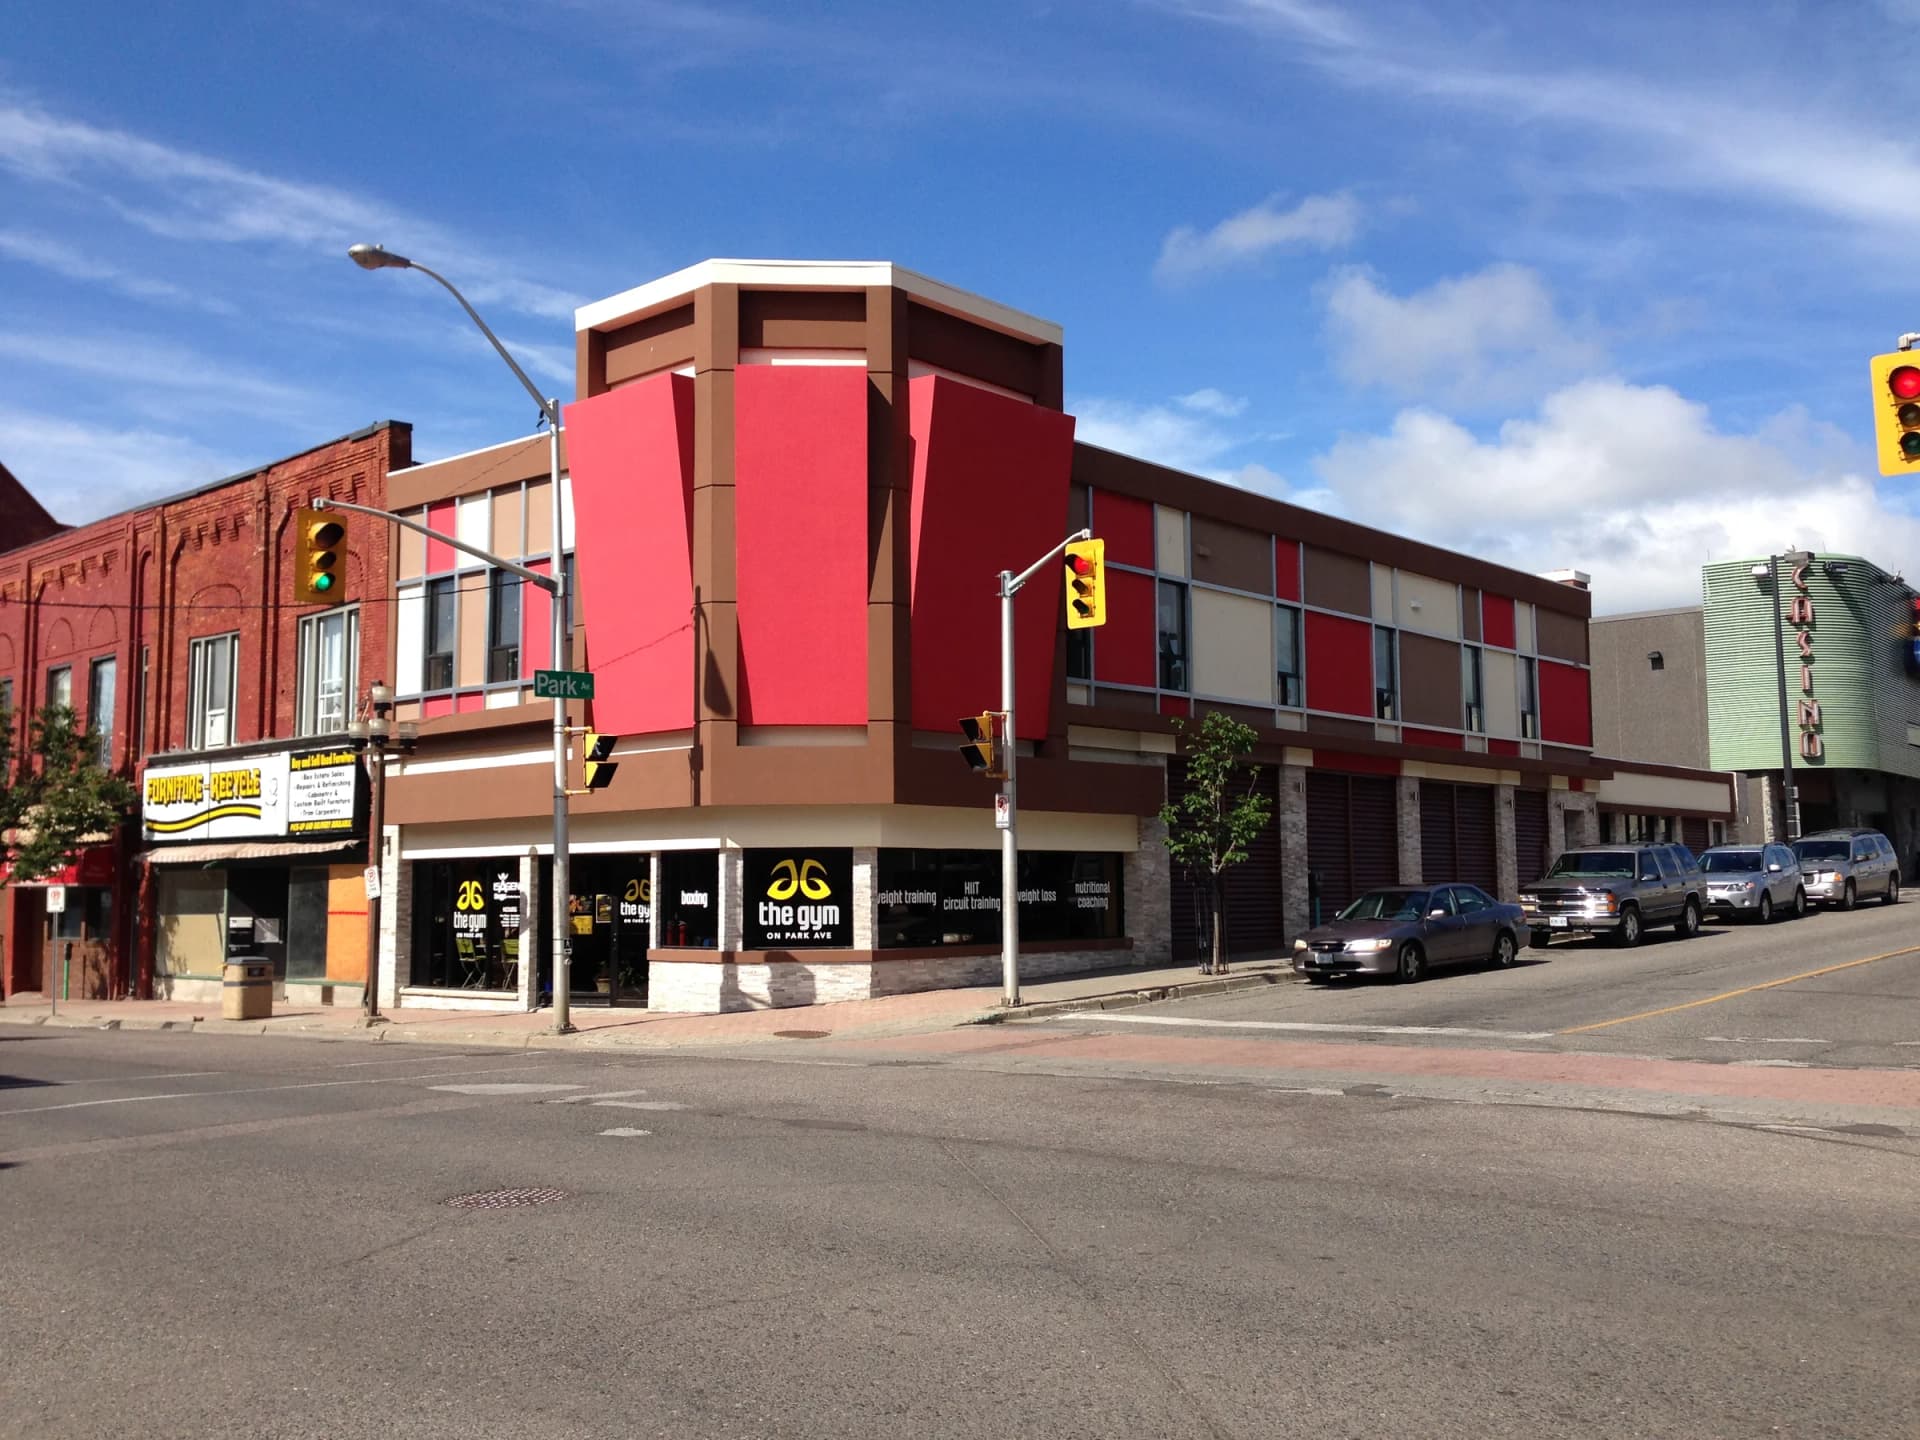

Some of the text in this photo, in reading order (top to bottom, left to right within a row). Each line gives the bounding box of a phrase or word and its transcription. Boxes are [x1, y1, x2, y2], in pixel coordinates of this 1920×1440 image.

[1791, 564, 1823, 758] CASINO
[536, 673, 577, 696] Park
[147, 774, 204, 807] FURNITURE
[210, 768, 261, 804] RECYCLE
[964, 881, 980, 895] HIIT
[1041, 888, 1057, 902] loss
[1075, 881, 1111, 894] nutritional
[680, 890, 708, 908] boxing
[904, 889, 937, 906] training
[943, 895, 1001, 912] circuit training
[1077, 896, 1108, 911] coaching
[620, 902, 651, 918] the gy
[759, 901, 840, 931] the gym
[453, 911, 468, 929] the
[469, 914, 487, 932] gym
[766, 932, 832, 940] ON PARK AVE
